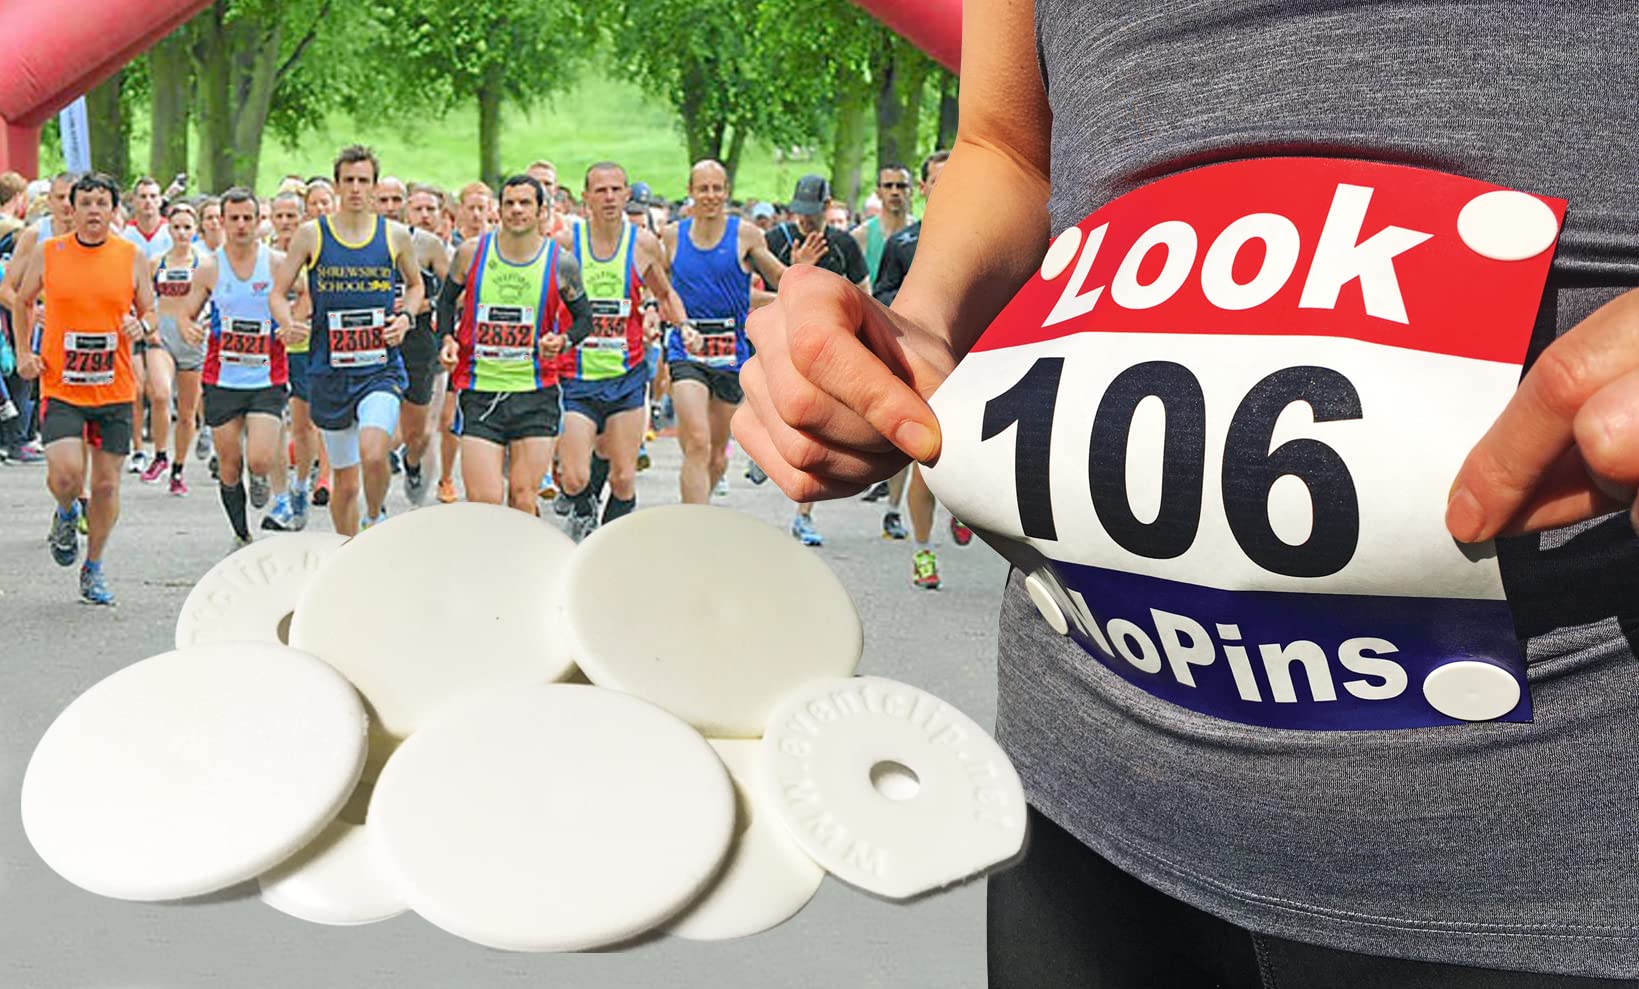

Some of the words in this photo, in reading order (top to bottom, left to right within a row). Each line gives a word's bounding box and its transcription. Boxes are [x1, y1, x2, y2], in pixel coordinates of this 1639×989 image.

[1041, 183, 1434, 327] Look
[317, 281, 369, 292] SCHOOL
[222, 332, 267, 354] 2321
[334, 327, 384, 352] 2308
[478, 323, 532, 347] 2832
[65, 350, 115, 371] 2794
[980, 356, 1364, 578] 106
